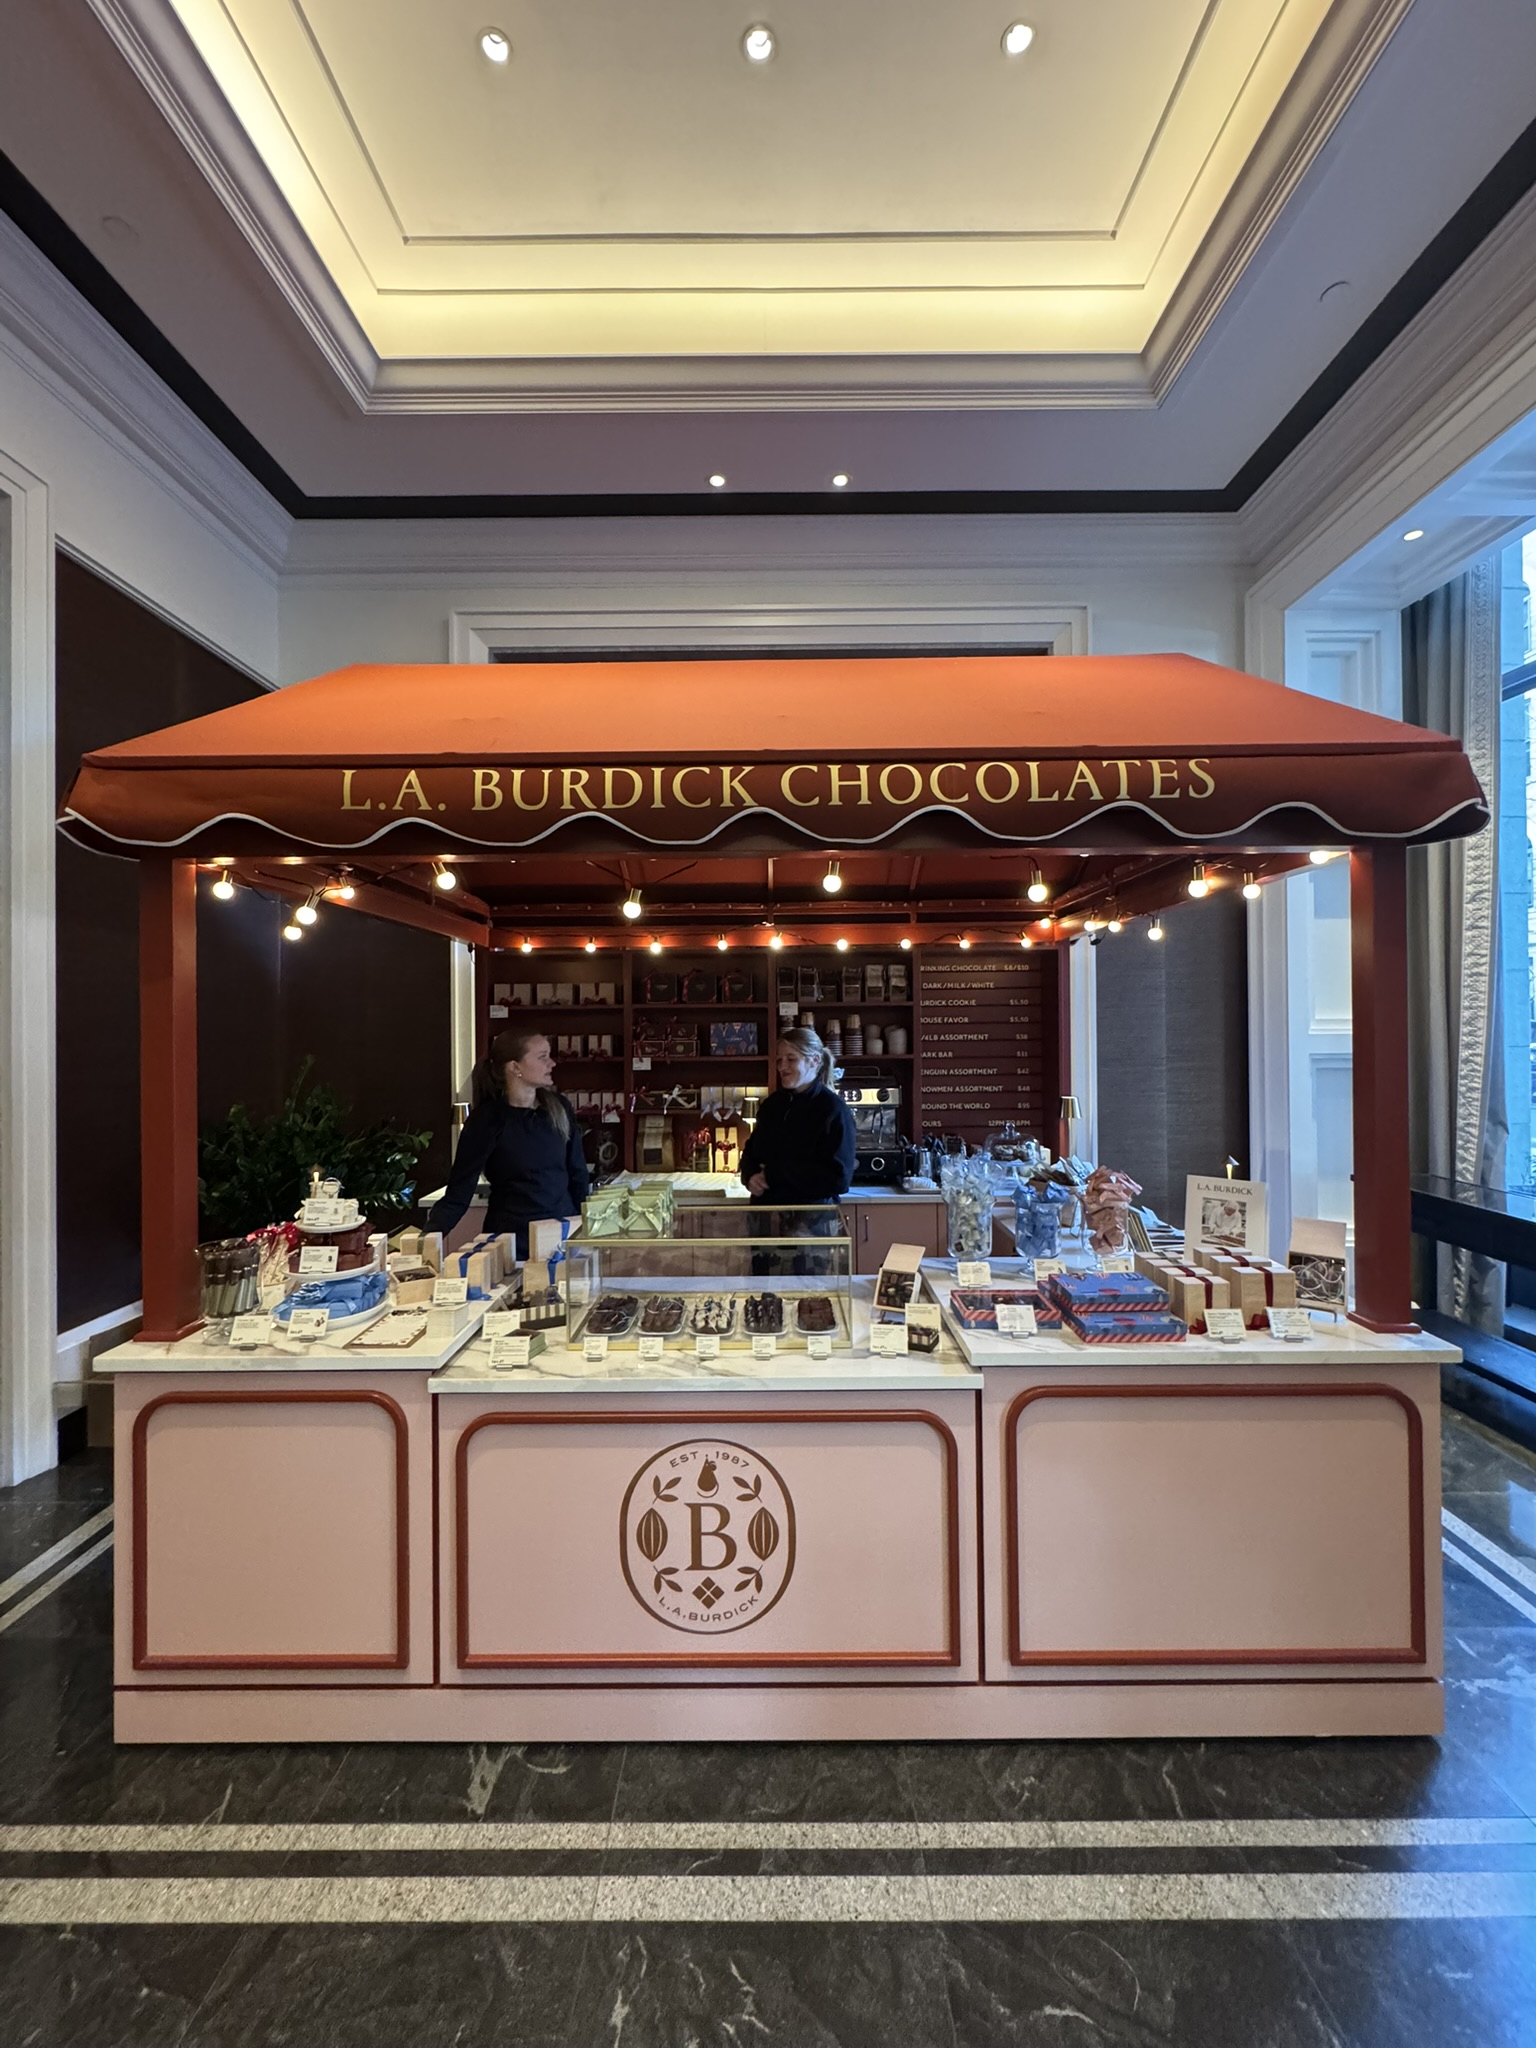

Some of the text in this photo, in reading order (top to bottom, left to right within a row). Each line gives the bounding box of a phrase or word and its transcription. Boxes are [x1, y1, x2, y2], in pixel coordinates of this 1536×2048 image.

[340, 758, 1216, 811] L.A. BURDICK CHOCOLATES
[1213, 1184, 1253, 1195] BURDICK
[669, 1451, 750, 1469] EST 1987
[683, 1502, 737, 1571] B
